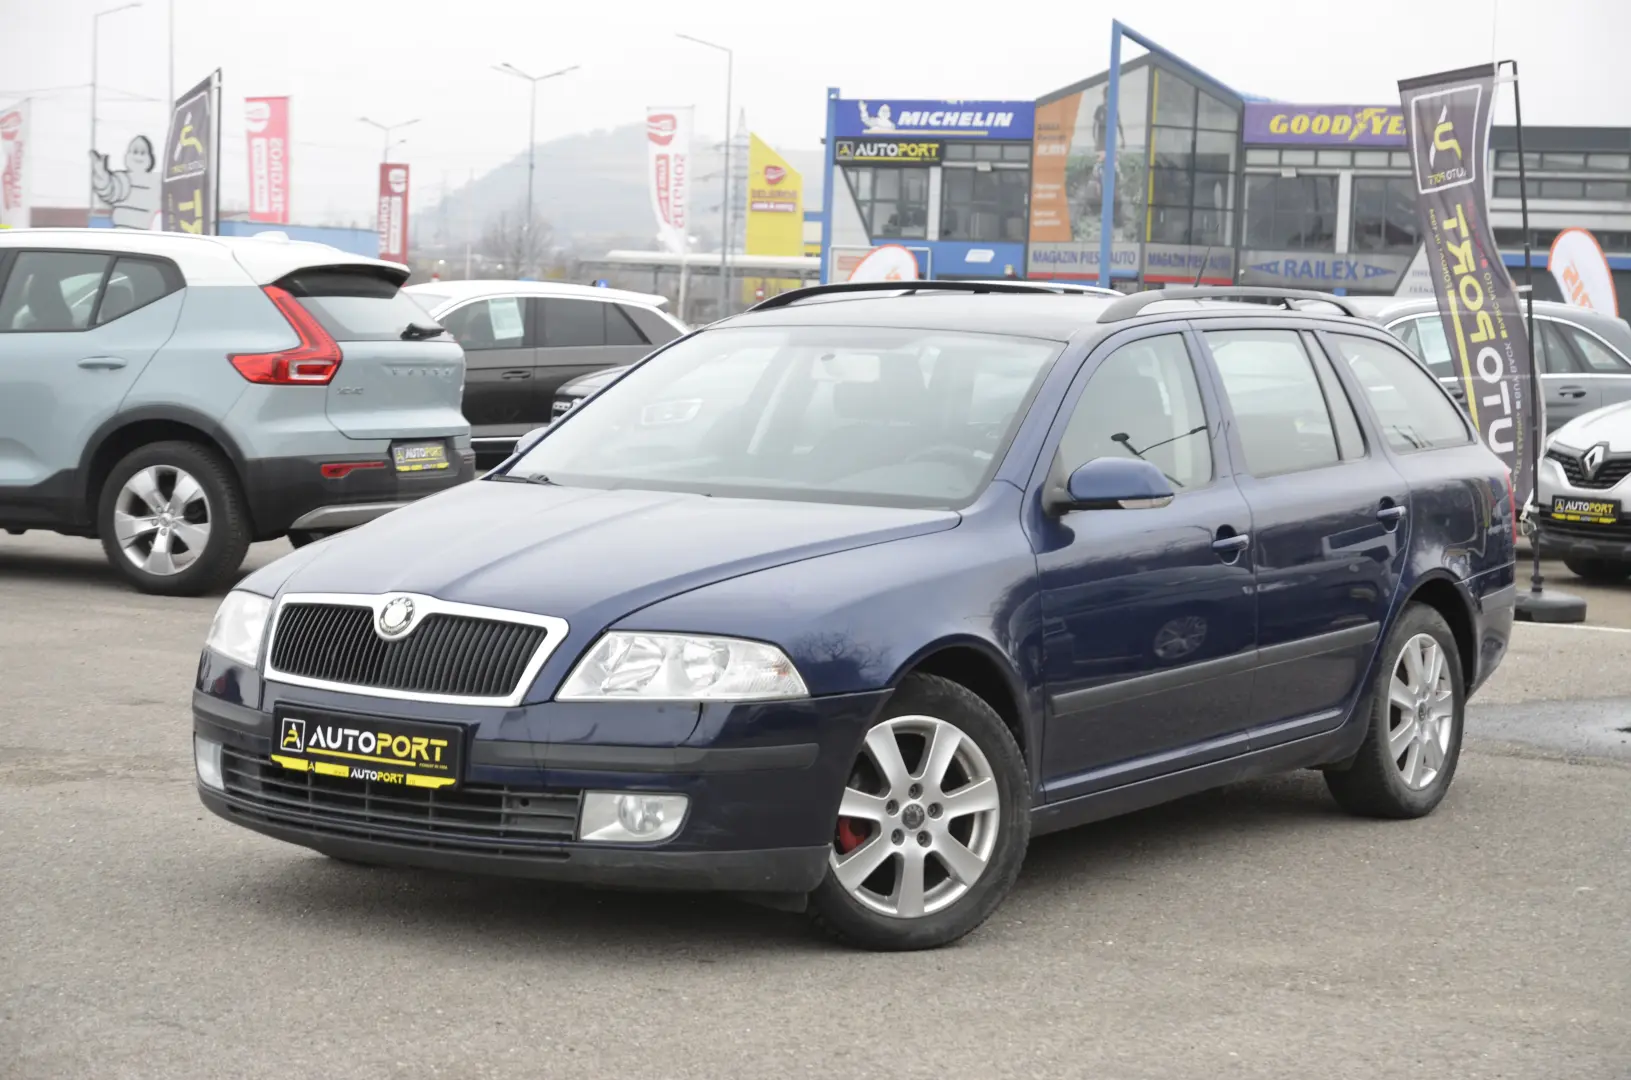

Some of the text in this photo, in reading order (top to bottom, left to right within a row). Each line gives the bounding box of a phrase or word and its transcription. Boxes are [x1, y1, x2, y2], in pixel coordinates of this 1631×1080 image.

[897, 111, 1015, 128] MICHELIN
[854, 142, 940, 158] AUTOPORT
[1032, 250, 1078, 265] MAGAZIN
[1079, 251, 1100, 266] PIES
[1284, 260, 1359, 281] RAILEX
[405, 446, 444, 459] AUTOPORT
[1565, 501, 1614, 514] AUTOPORT
[309, 724, 448, 762] AUTOPORT
[351, 768, 404, 784] AUTOPORT
